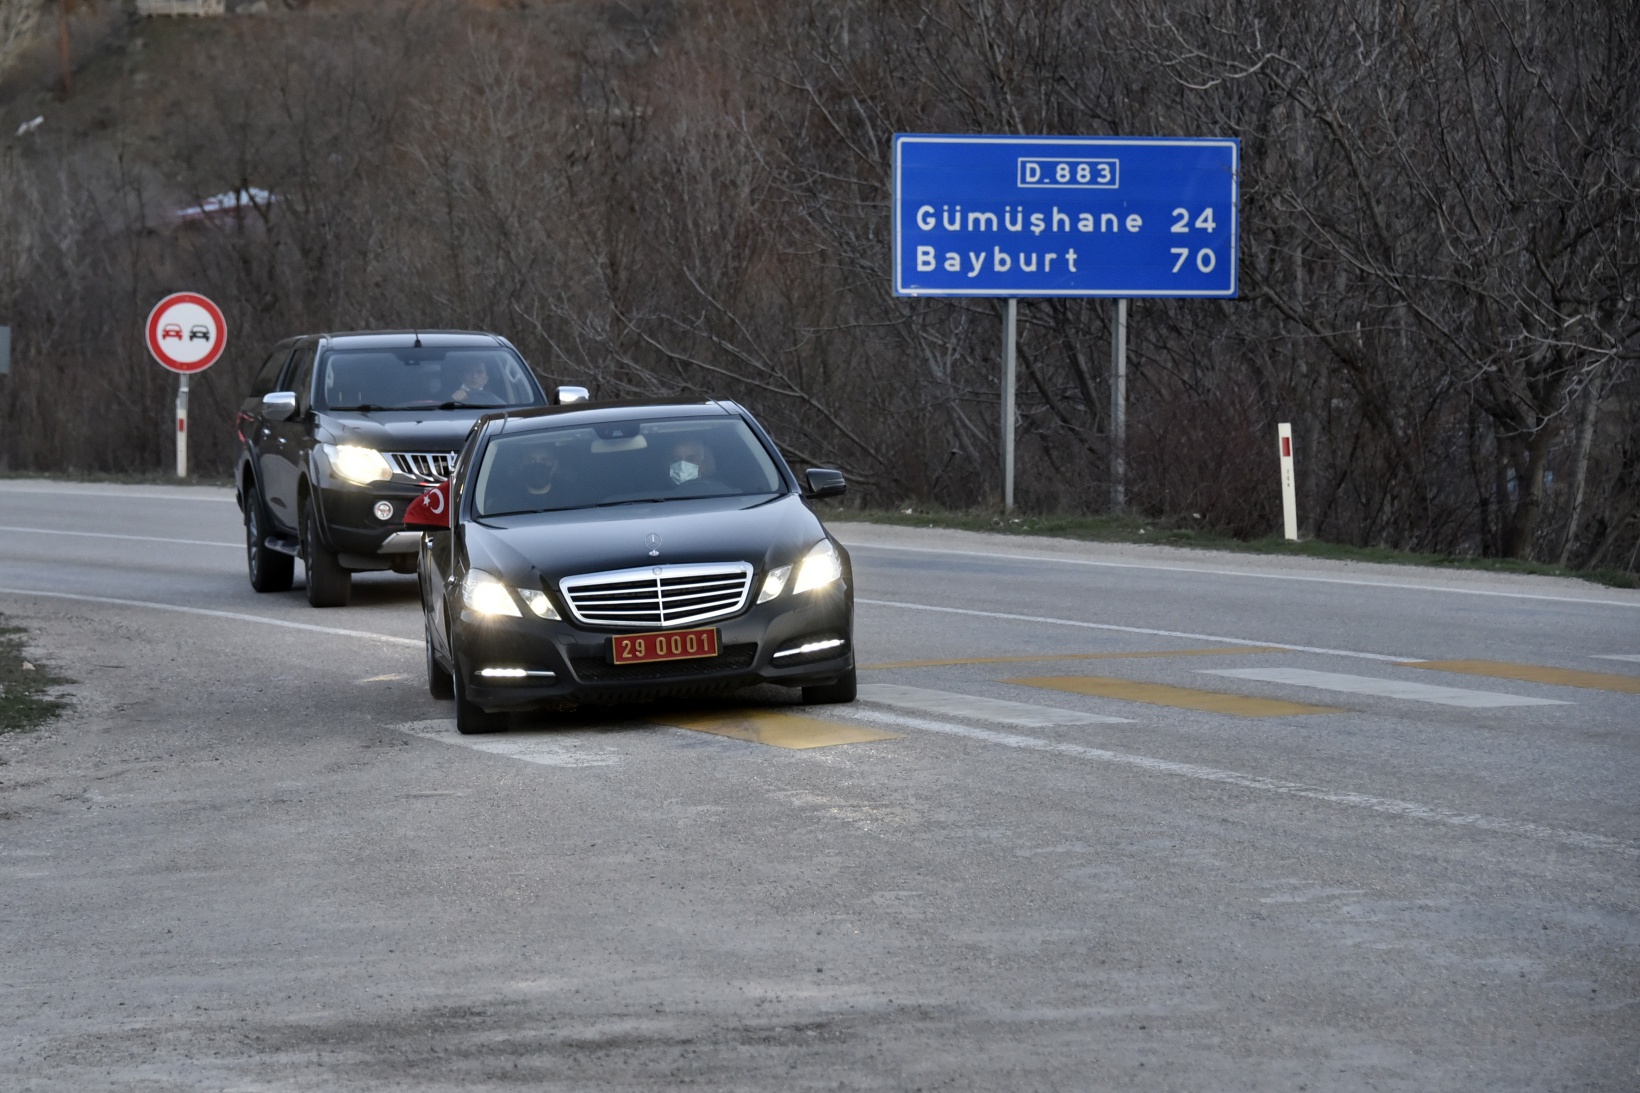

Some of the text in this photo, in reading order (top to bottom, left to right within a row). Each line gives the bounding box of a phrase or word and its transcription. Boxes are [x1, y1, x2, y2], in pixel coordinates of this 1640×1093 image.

[1025, 162, 1111, 183] D.883
[916, 204, 1217, 236] Gümüşhane 24
[916, 245, 1216, 278] Bayburt 70
[622, 634, 708, 658] 29 0001
